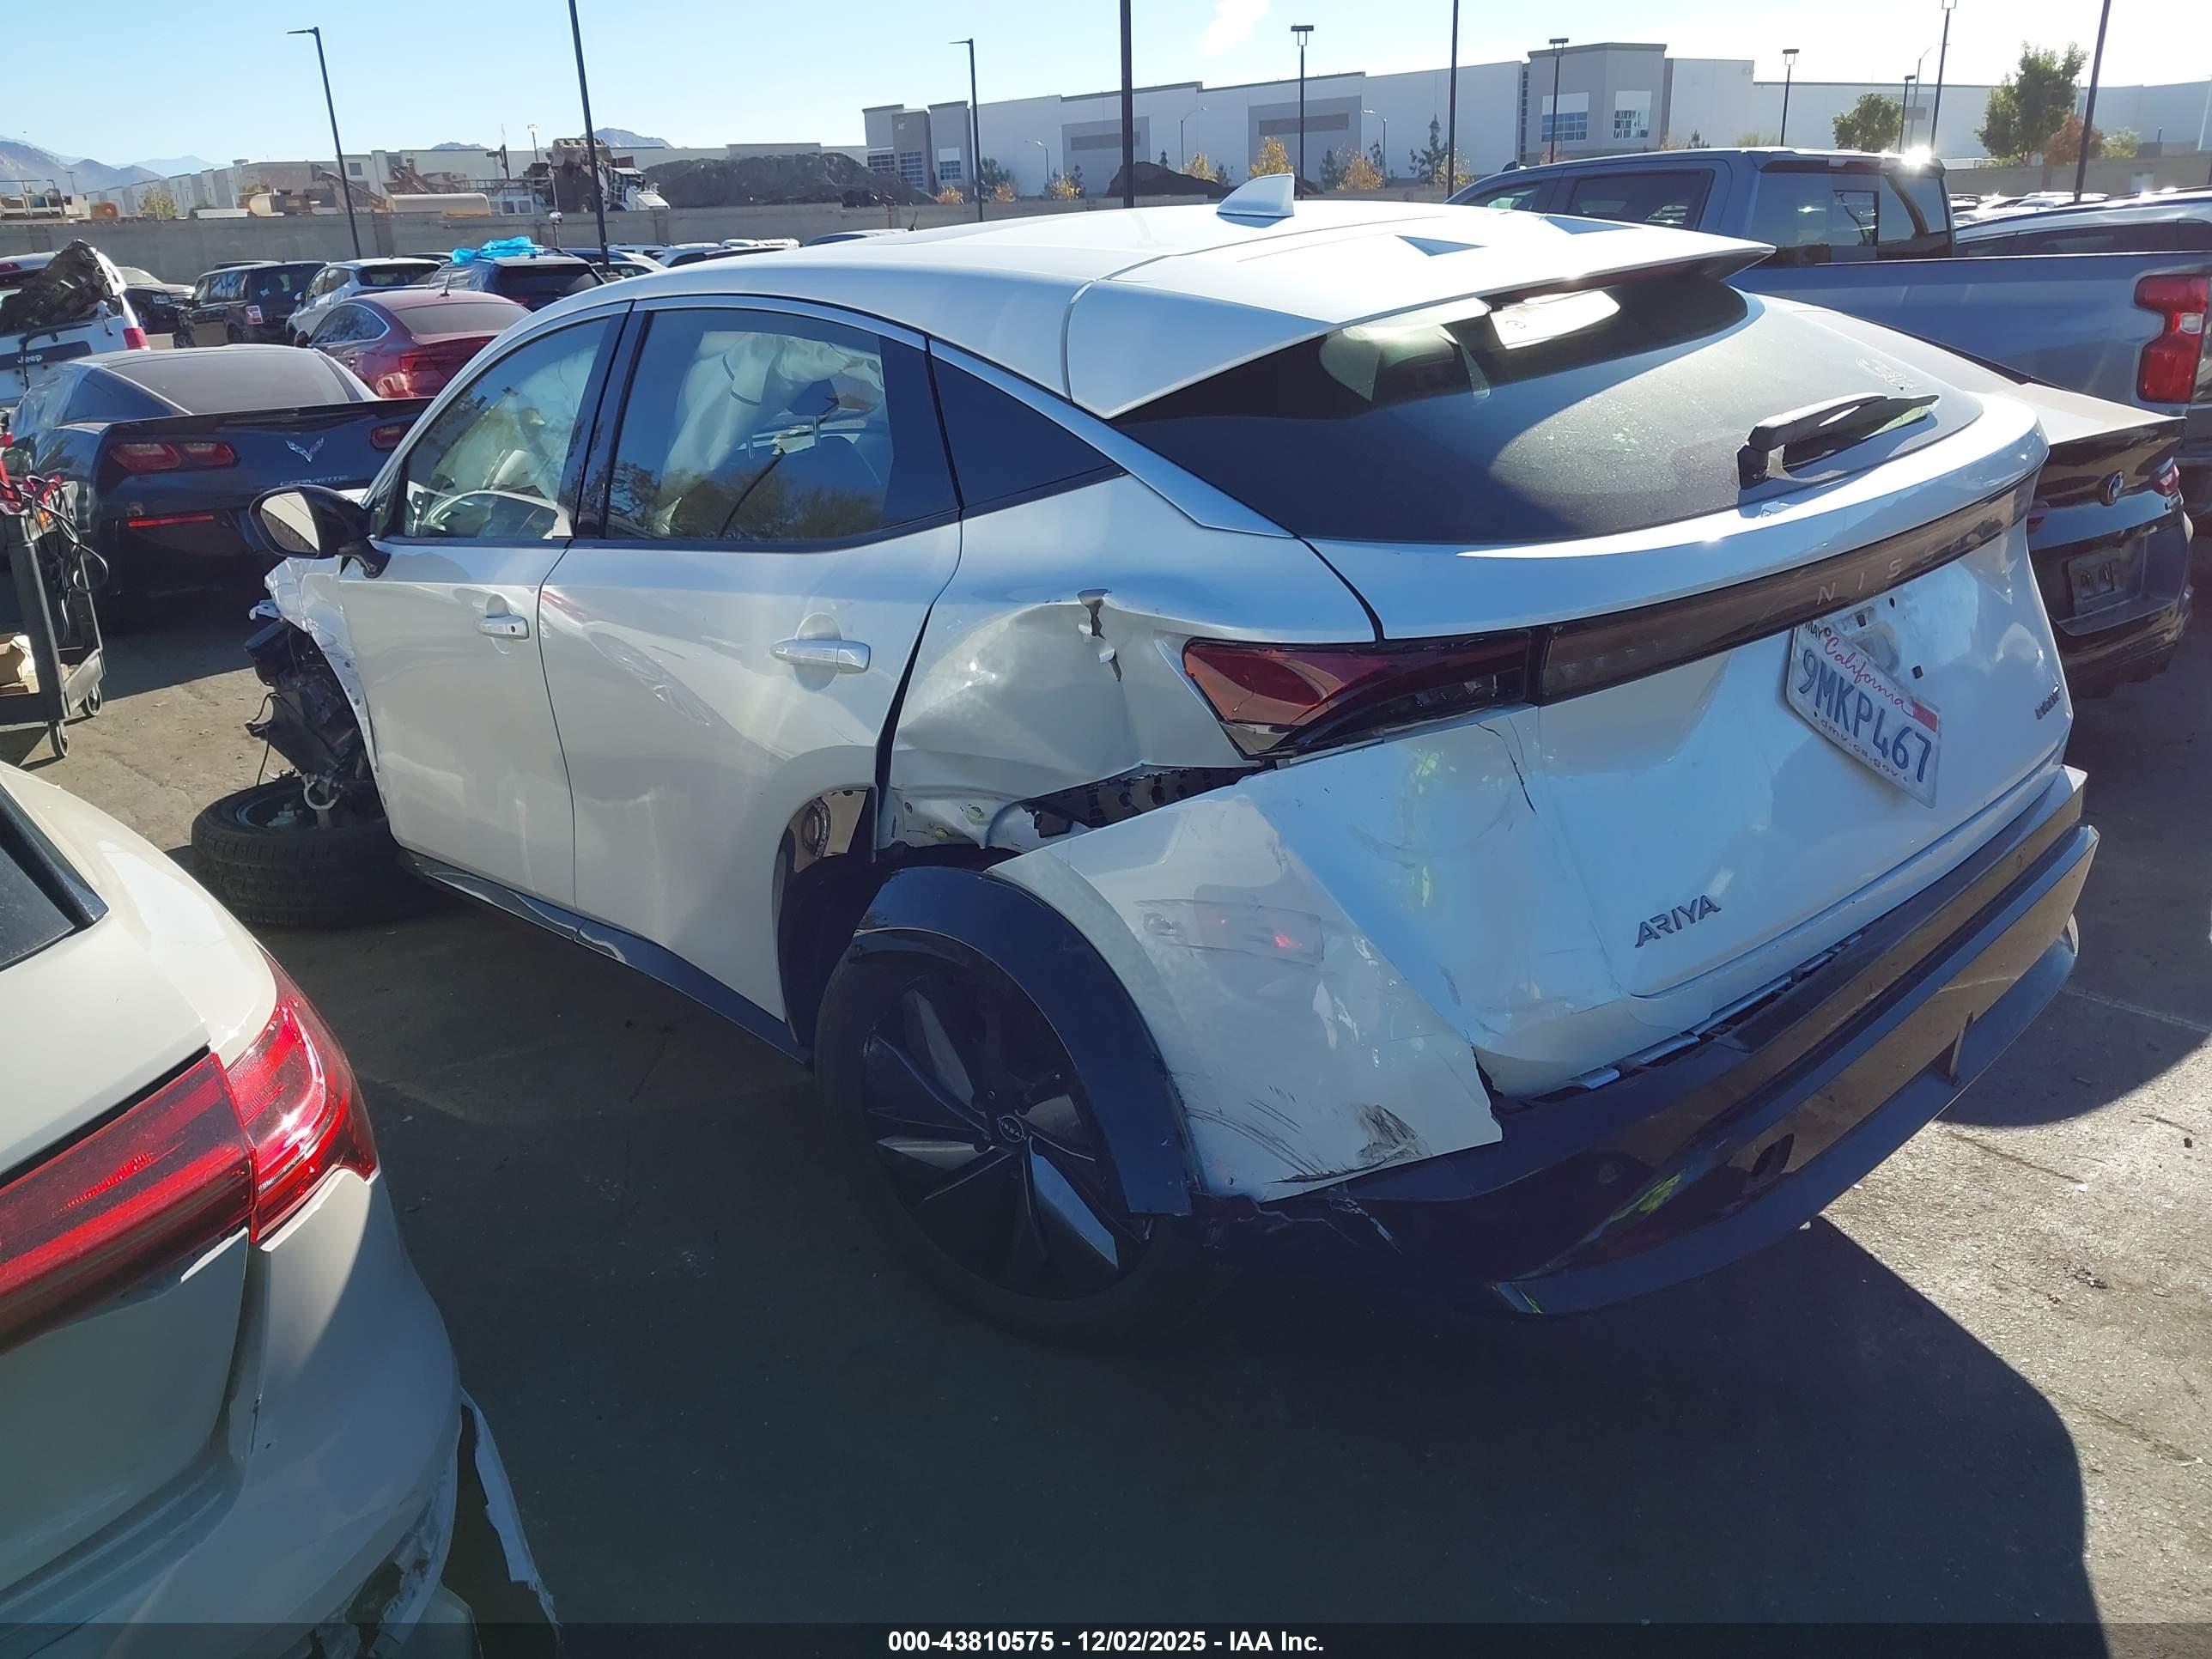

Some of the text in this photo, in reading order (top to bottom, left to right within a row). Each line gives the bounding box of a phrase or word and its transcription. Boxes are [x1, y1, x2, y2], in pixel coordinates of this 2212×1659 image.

[17, 355, 42, 364] Jeep
[1824, 636, 1914, 717] California
[1799, 649, 1931, 782] 9MKP467
[1820, 720, 1899, 776] dmv.ca.gov
[1635, 895, 1721, 948] ARIYA
